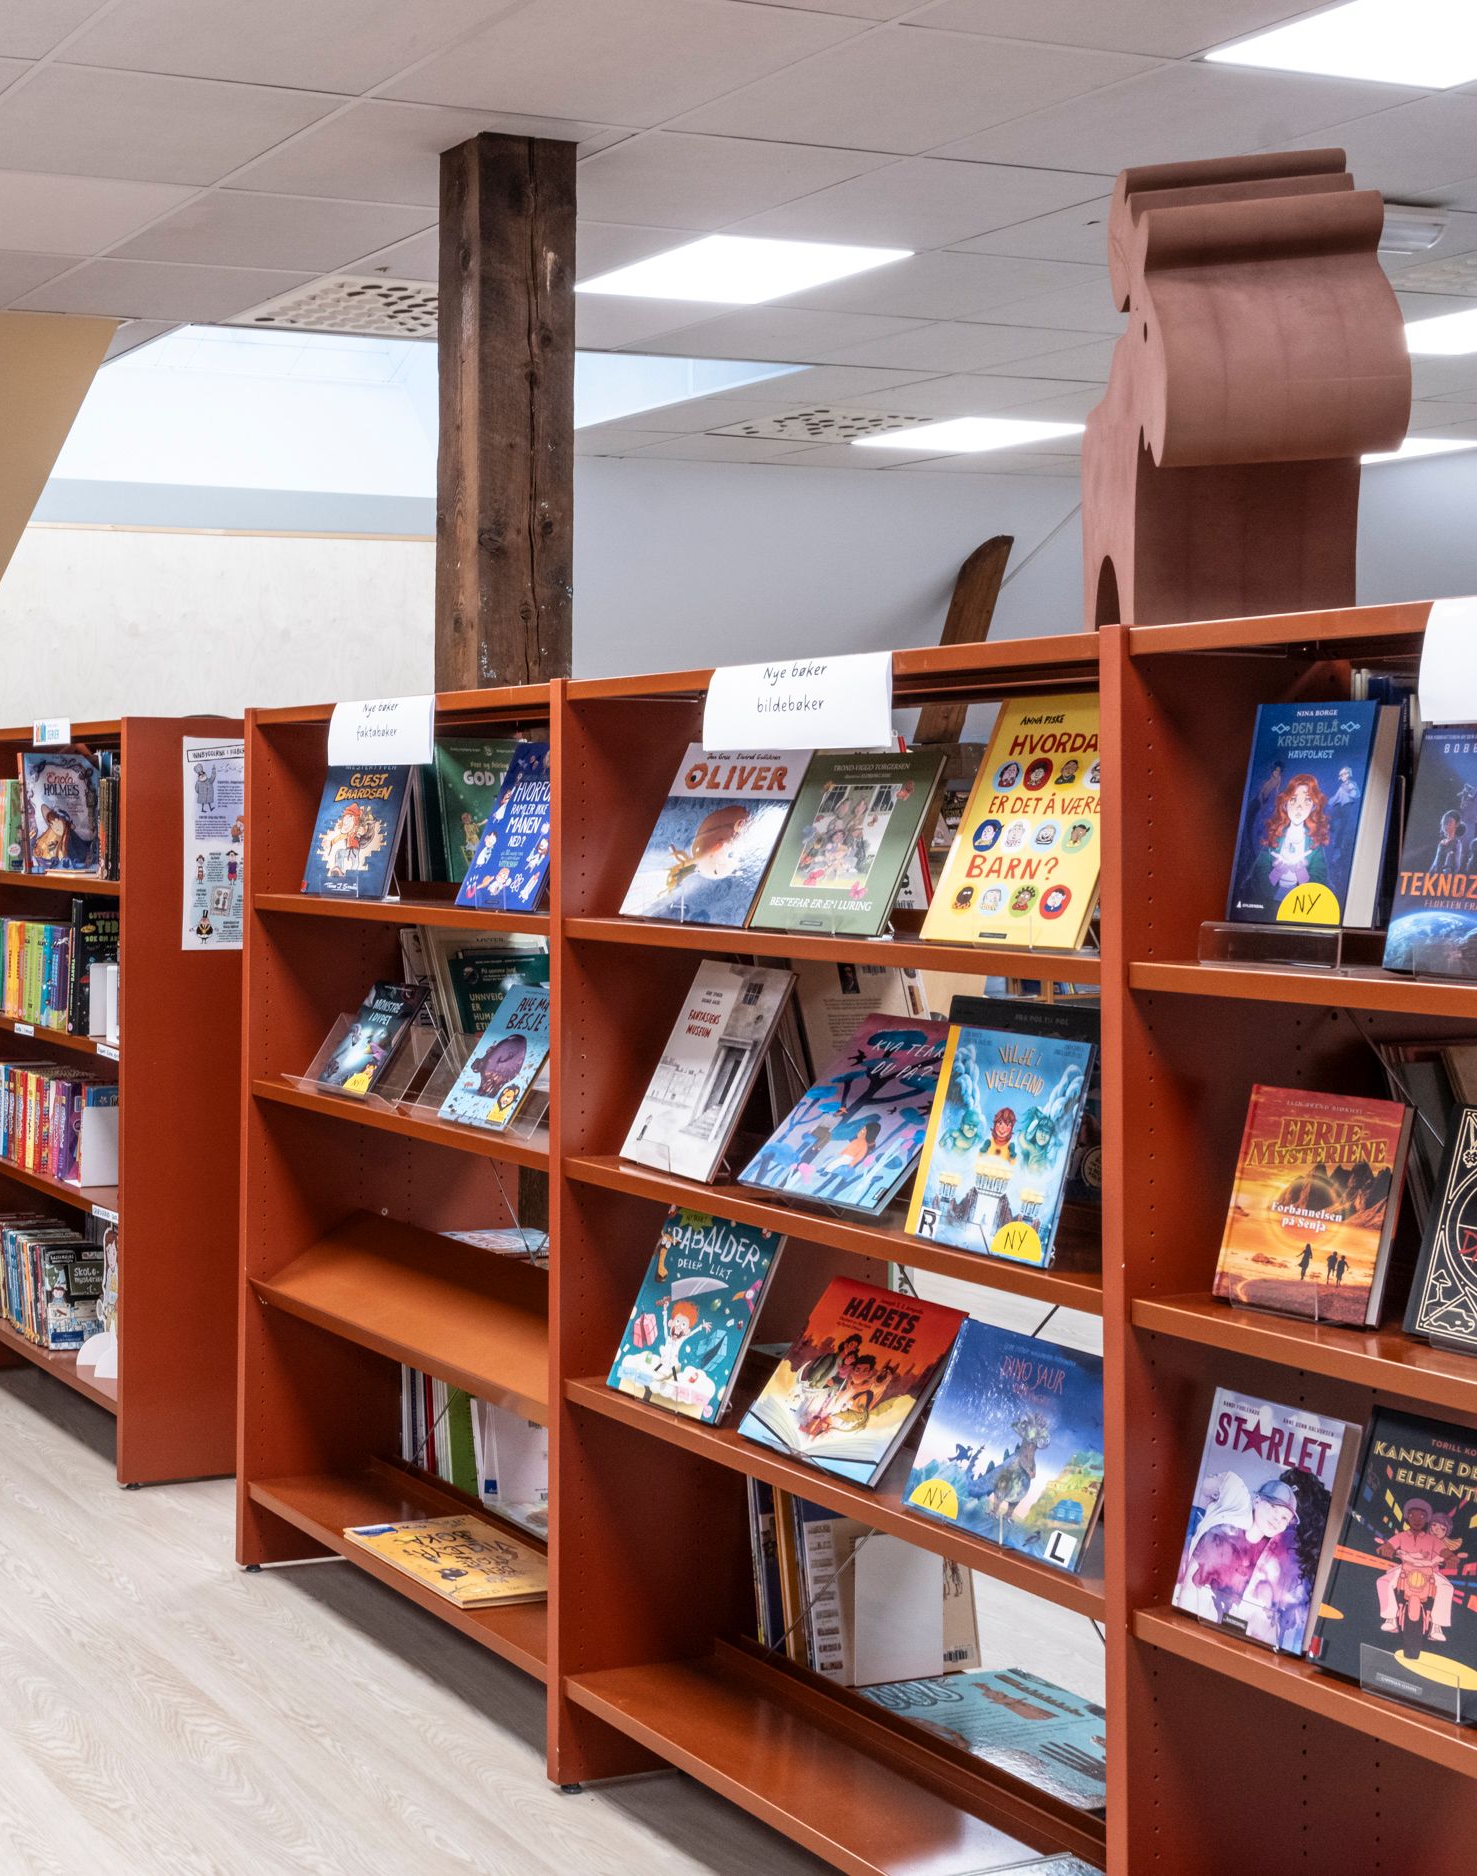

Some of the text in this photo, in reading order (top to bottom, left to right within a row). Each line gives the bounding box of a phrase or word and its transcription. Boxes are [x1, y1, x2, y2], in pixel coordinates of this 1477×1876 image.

[763, 661, 827, 686] Nye bøker
[363, 703, 399, 718] Nye bøker
[757, 694, 824, 713] bildebøker
[1020, 714, 1066, 726] ANNA FISKE
[1291, 719, 1339, 734] DEN BLÅ
[356, 724, 398, 741] faktabøker
[1277, 734, 1350, 747] KRYSTALLEN
[1288, 749, 1335, 759] HAVFOLKET
[350, 773, 389, 787] GJEST
[463, 770, 495, 786] GOD
[685, 762, 788, 791] OLIVER
[43, 783, 80, 797] HOLMES
[334, 785, 394, 802] BAARDSEN
[988, 792, 1100, 815] ER DET Å VÆRE
[965, 854, 1061, 881] BARN?
[769, 896, 809, 908] BESTEFAR
[810, 898, 822, 908] ER
[838, 901, 873, 911] LURING
[1293, 893, 1321, 915] NY
[1464, 901, 1477, 910] FR
[469, 993, 504, 1001] UNNVEIG
[471, 1003, 481, 1011] ER
[688, 1009, 721, 1025] FANTASIENS
[686, 1023, 712, 1038] MUSEUM
[871, 1061, 896, 1079] DU
[1277, 1116, 1370, 1149] FERIE-
[1271, 1201, 1343, 1223] Forbannelsen
[918, 1209, 937, 1237] R
[1281, 1216, 1327, 1233] på Senja
[1004, 1230, 1028, 1251] NY
[672, 1226, 761, 1273] RABALDER
[677, 1258, 732, 1280] DELER LIKT
[843, 1297, 921, 1334] HÅPETS
[869, 1328, 916, 1354] REISE
[1431, 1439, 1462, 1453] TORILL
[1373, 1440, 1455, 1474] KANSKJE
[924, 1487, 952, 1508] NY
[1050, 1531, 1066, 1564] L
